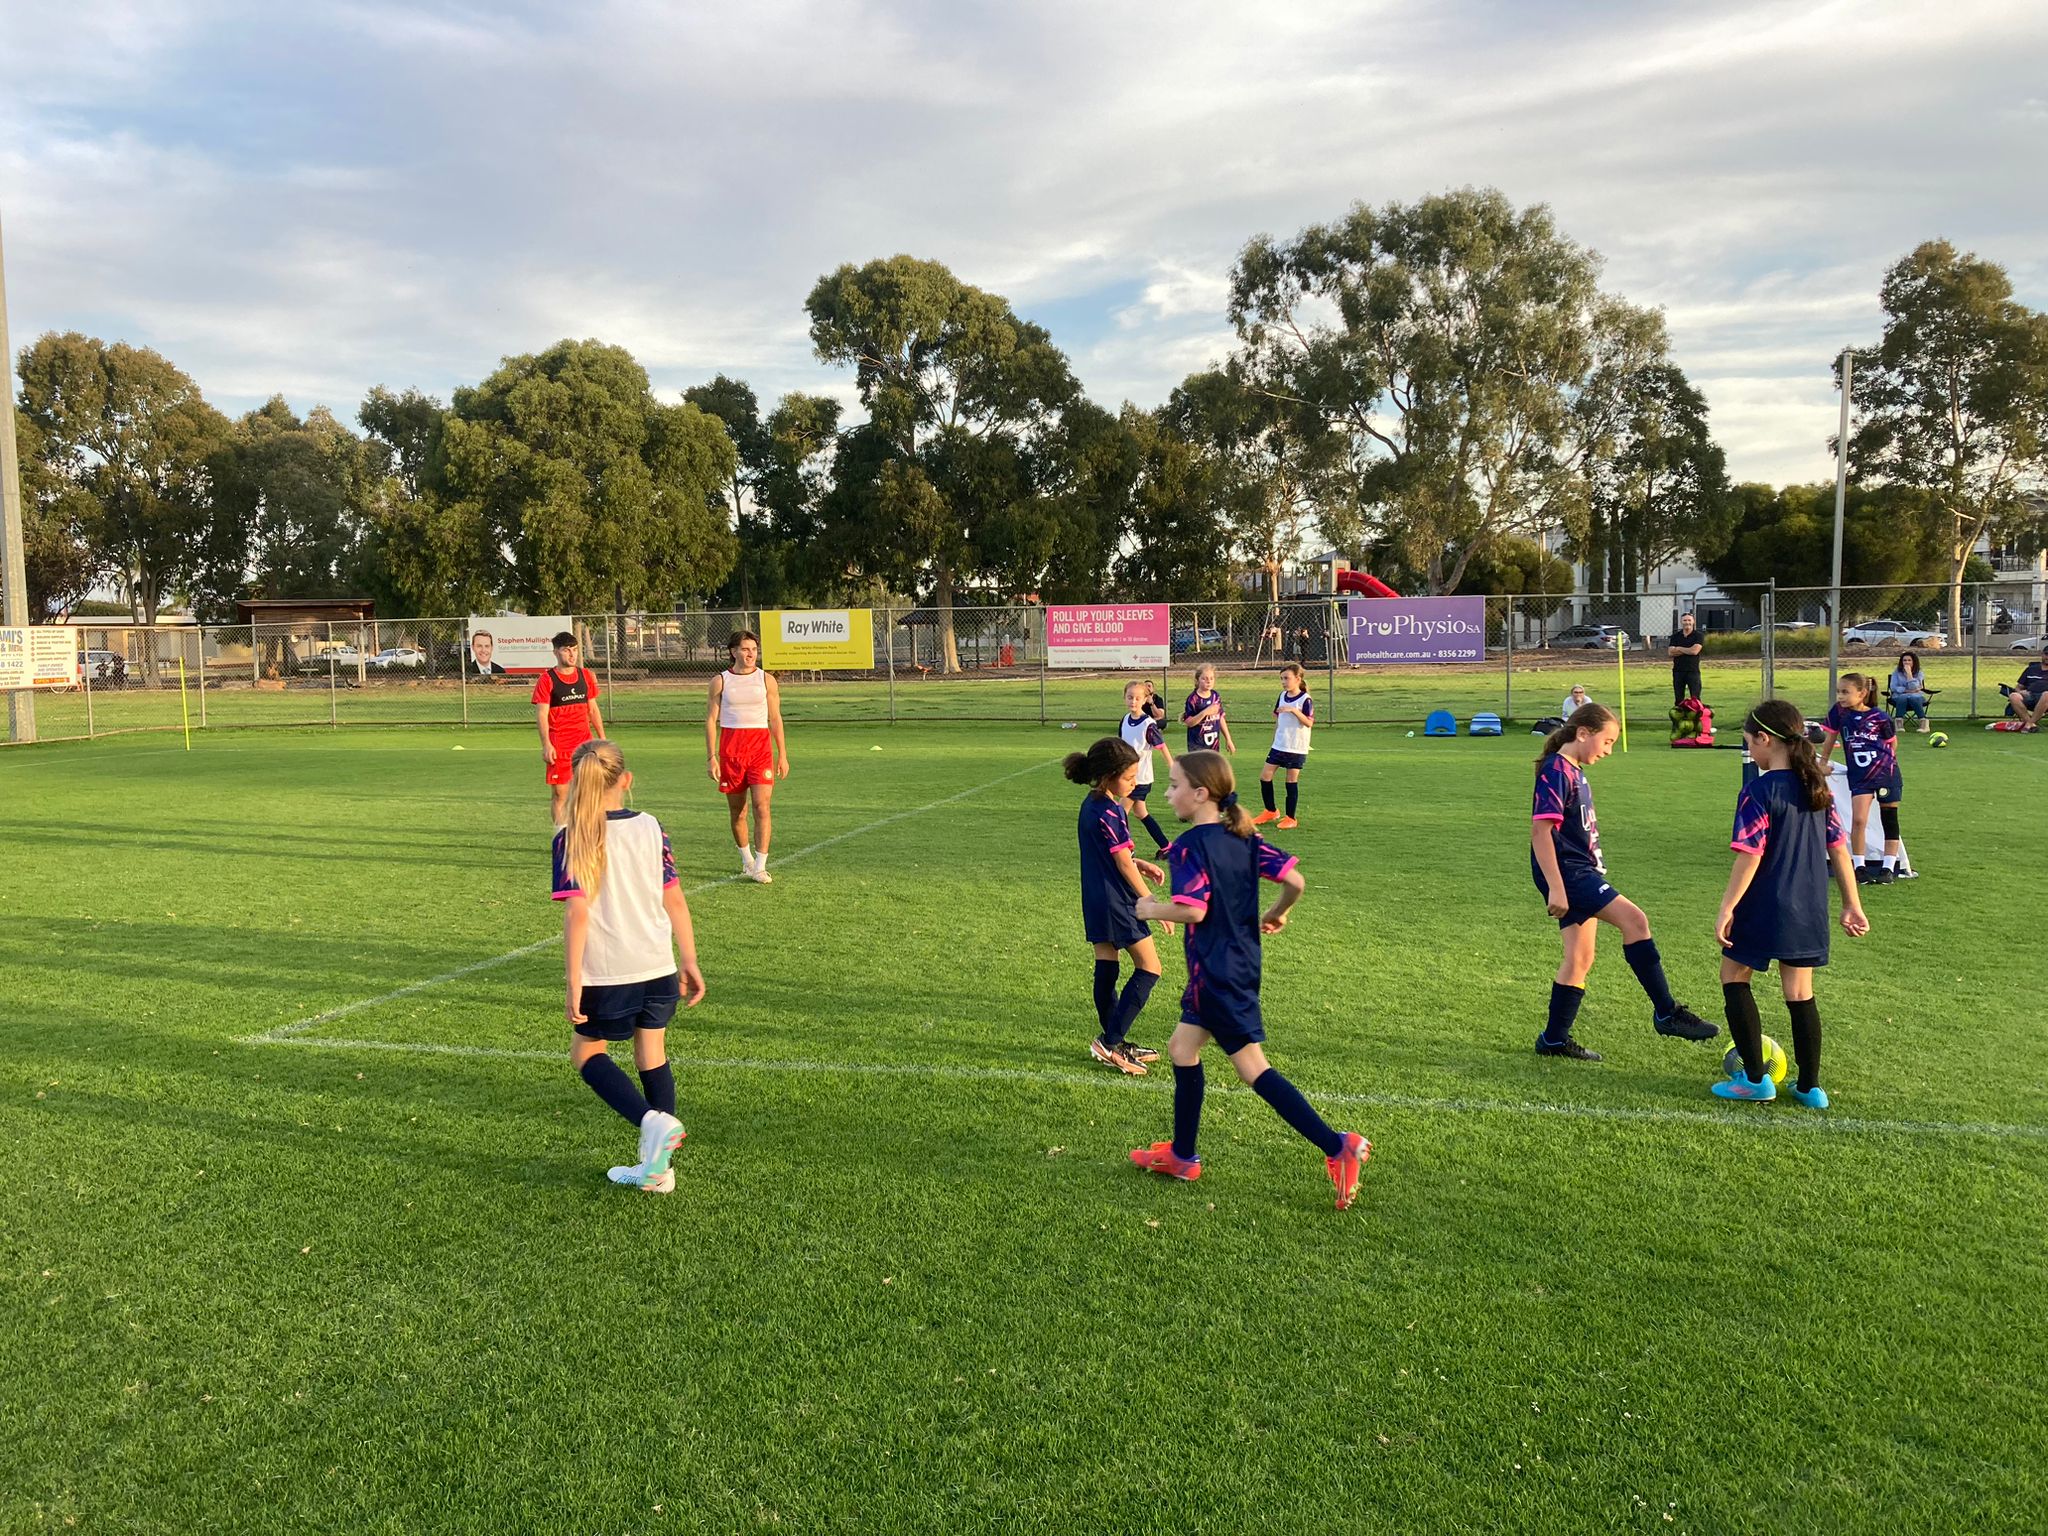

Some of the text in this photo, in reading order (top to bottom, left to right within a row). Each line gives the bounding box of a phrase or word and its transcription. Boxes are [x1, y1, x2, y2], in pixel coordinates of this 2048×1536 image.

[1053, 609, 1154, 622] ROLL UP YOUR SLEEVES
[787, 620, 844, 636] Ray White
[1053, 622, 1124, 634] AND GIVE BLOOD
[497, 637, 553, 645] Stephen Mulligh
[1356, 649, 1477, 660] prohealthcare.com.au 8356 2299
[561, 694, 585, 702] CATAPULT
